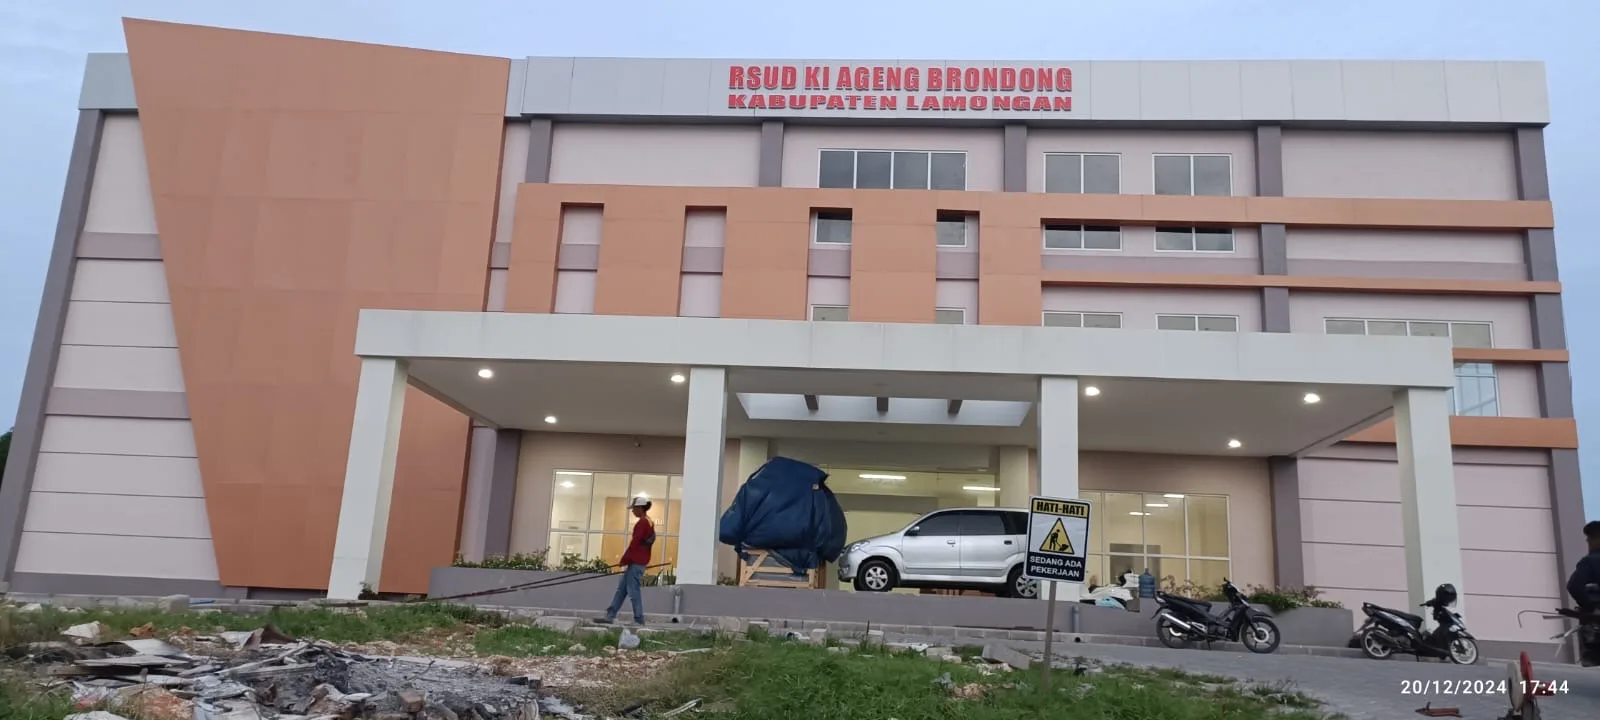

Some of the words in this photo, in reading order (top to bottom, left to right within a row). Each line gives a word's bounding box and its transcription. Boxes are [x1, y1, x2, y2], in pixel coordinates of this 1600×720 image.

[729, 65, 797, 91] RSUD
[804, 66, 830, 91] KI
[837, 66, 920, 91] AGENG
[927, 67, 1073, 92] BRONDONG
[728, 94, 898, 110] KABUPATEN
[906, 95, 1073, 111] LAMONGAN
[1036, 501, 1085, 516] HATI-HATI
[1030, 556, 1064, 567] SEDANG
[1064, 560, 1082, 568] ADA
[1030, 565, 1080, 577] PEKERJAAN
